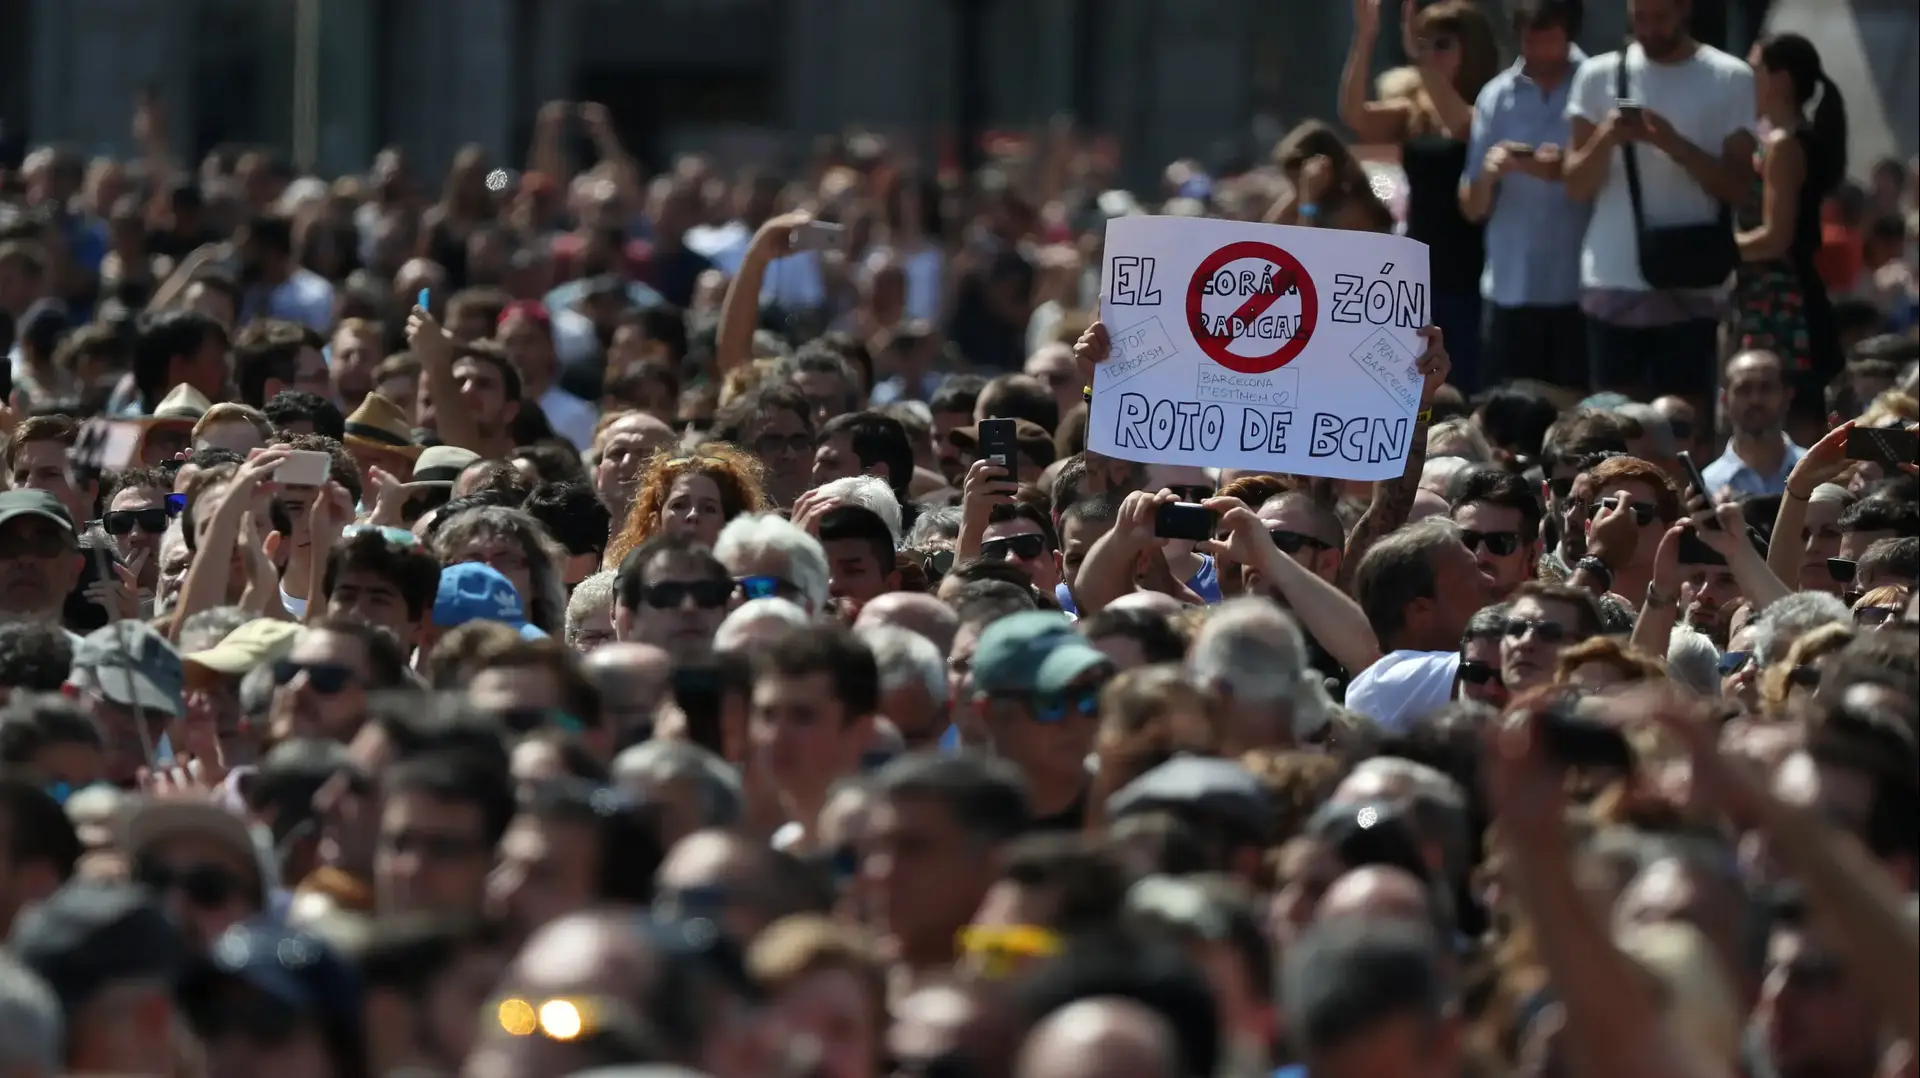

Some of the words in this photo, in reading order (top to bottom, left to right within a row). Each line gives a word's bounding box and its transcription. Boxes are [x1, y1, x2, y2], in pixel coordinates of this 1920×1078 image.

[1110, 256, 1161, 306] EL
[1331, 262, 1424, 328] ZÓN
[1110, 329, 1146, 358] STOP
[1196, 313, 1310, 339] RADICAL
[1101, 346, 1164, 378] TERRORISM
[1202, 372, 1273, 388] BARCELONA
[1362, 352, 1417, 408] BARCELONA
[1372, 337, 1402, 364] PRAY
[1404, 365, 1421, 388] FOR
[1115, 392, 1224, 451] ROTO
[1240, 407, 1292, 454] DE
[1309, 412, 1408, 463] BCN
